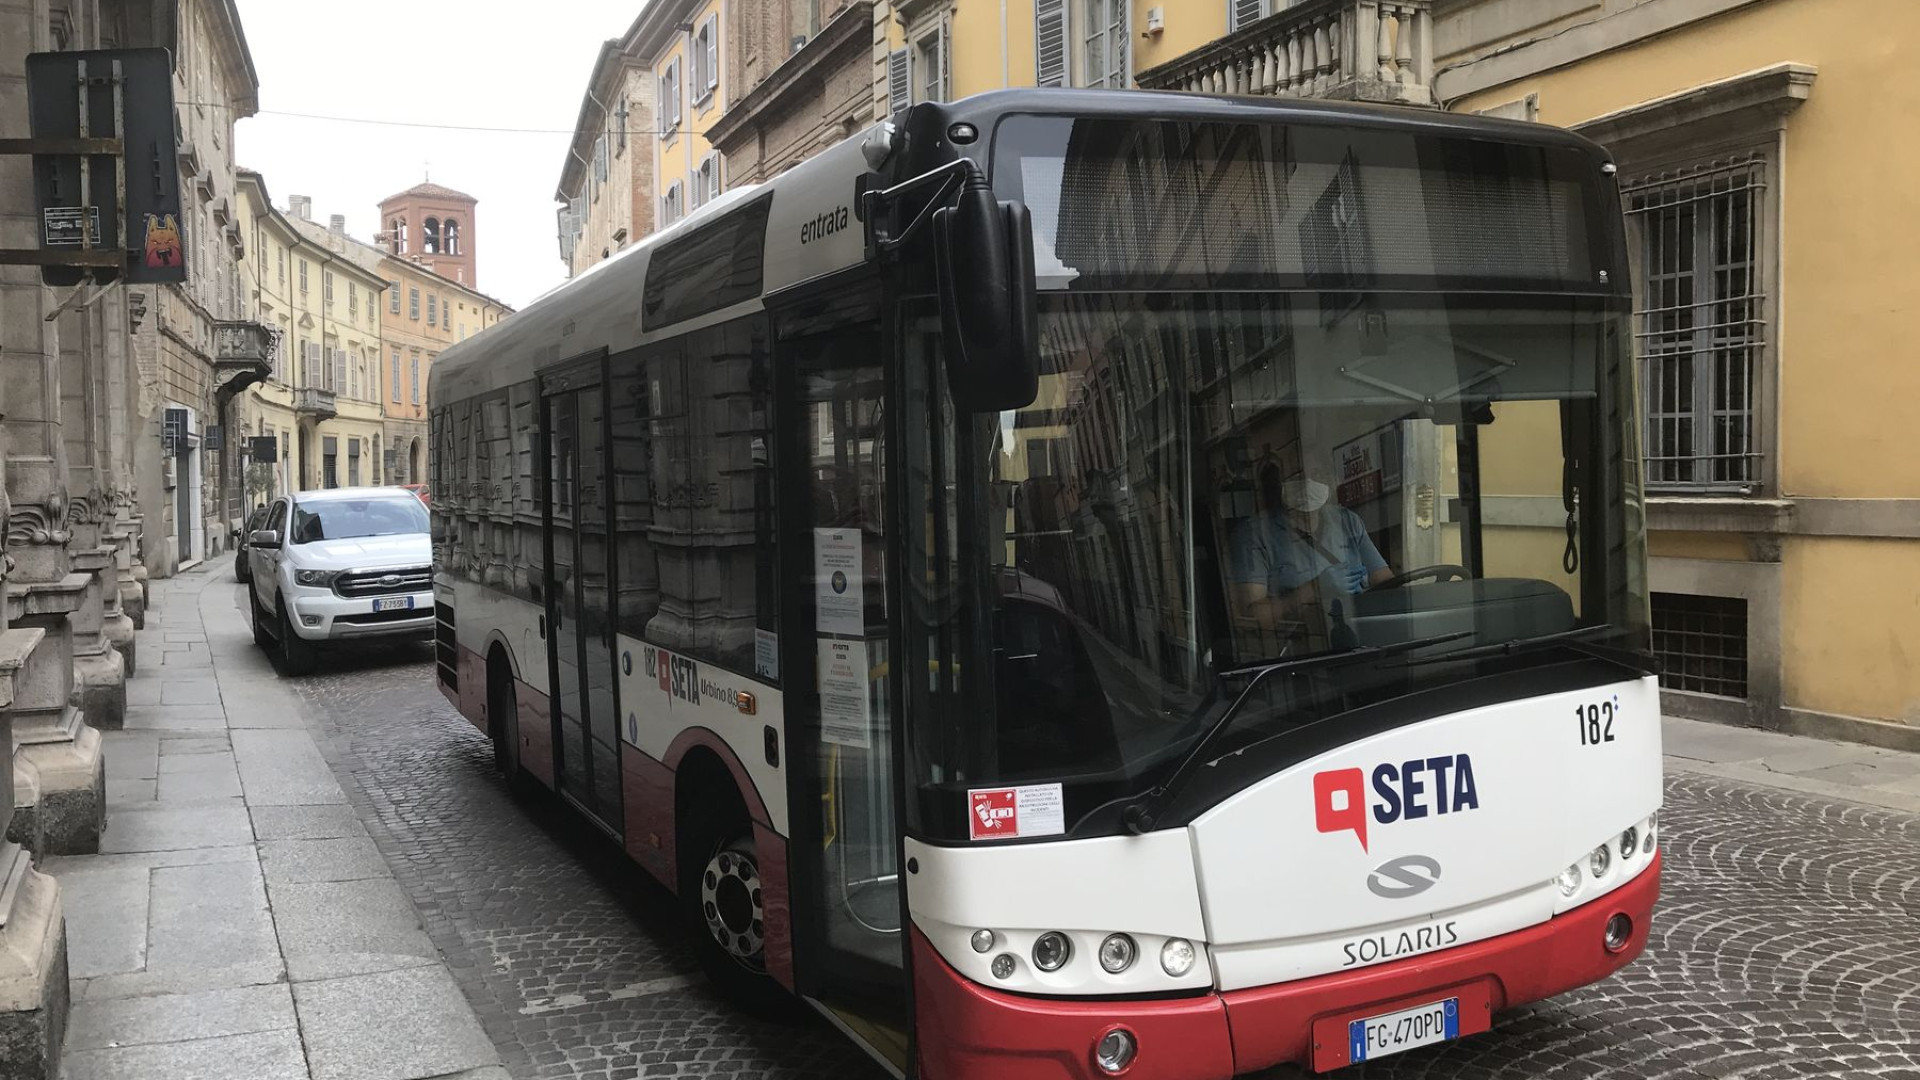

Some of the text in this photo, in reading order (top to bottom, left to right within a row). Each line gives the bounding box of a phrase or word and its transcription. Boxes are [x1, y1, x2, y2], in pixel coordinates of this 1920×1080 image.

[801, 205, 848, 245] entrata
[644, 645, 657, 679] 182
[670, 654, 701, 706] SETA
[701, 678, 727, 703] Urbino
[1576, 701, 1615, 746] 182
[1372, 753, 1479, 824] SETA
[1343, 921, 1457, 967] SOLARIS
